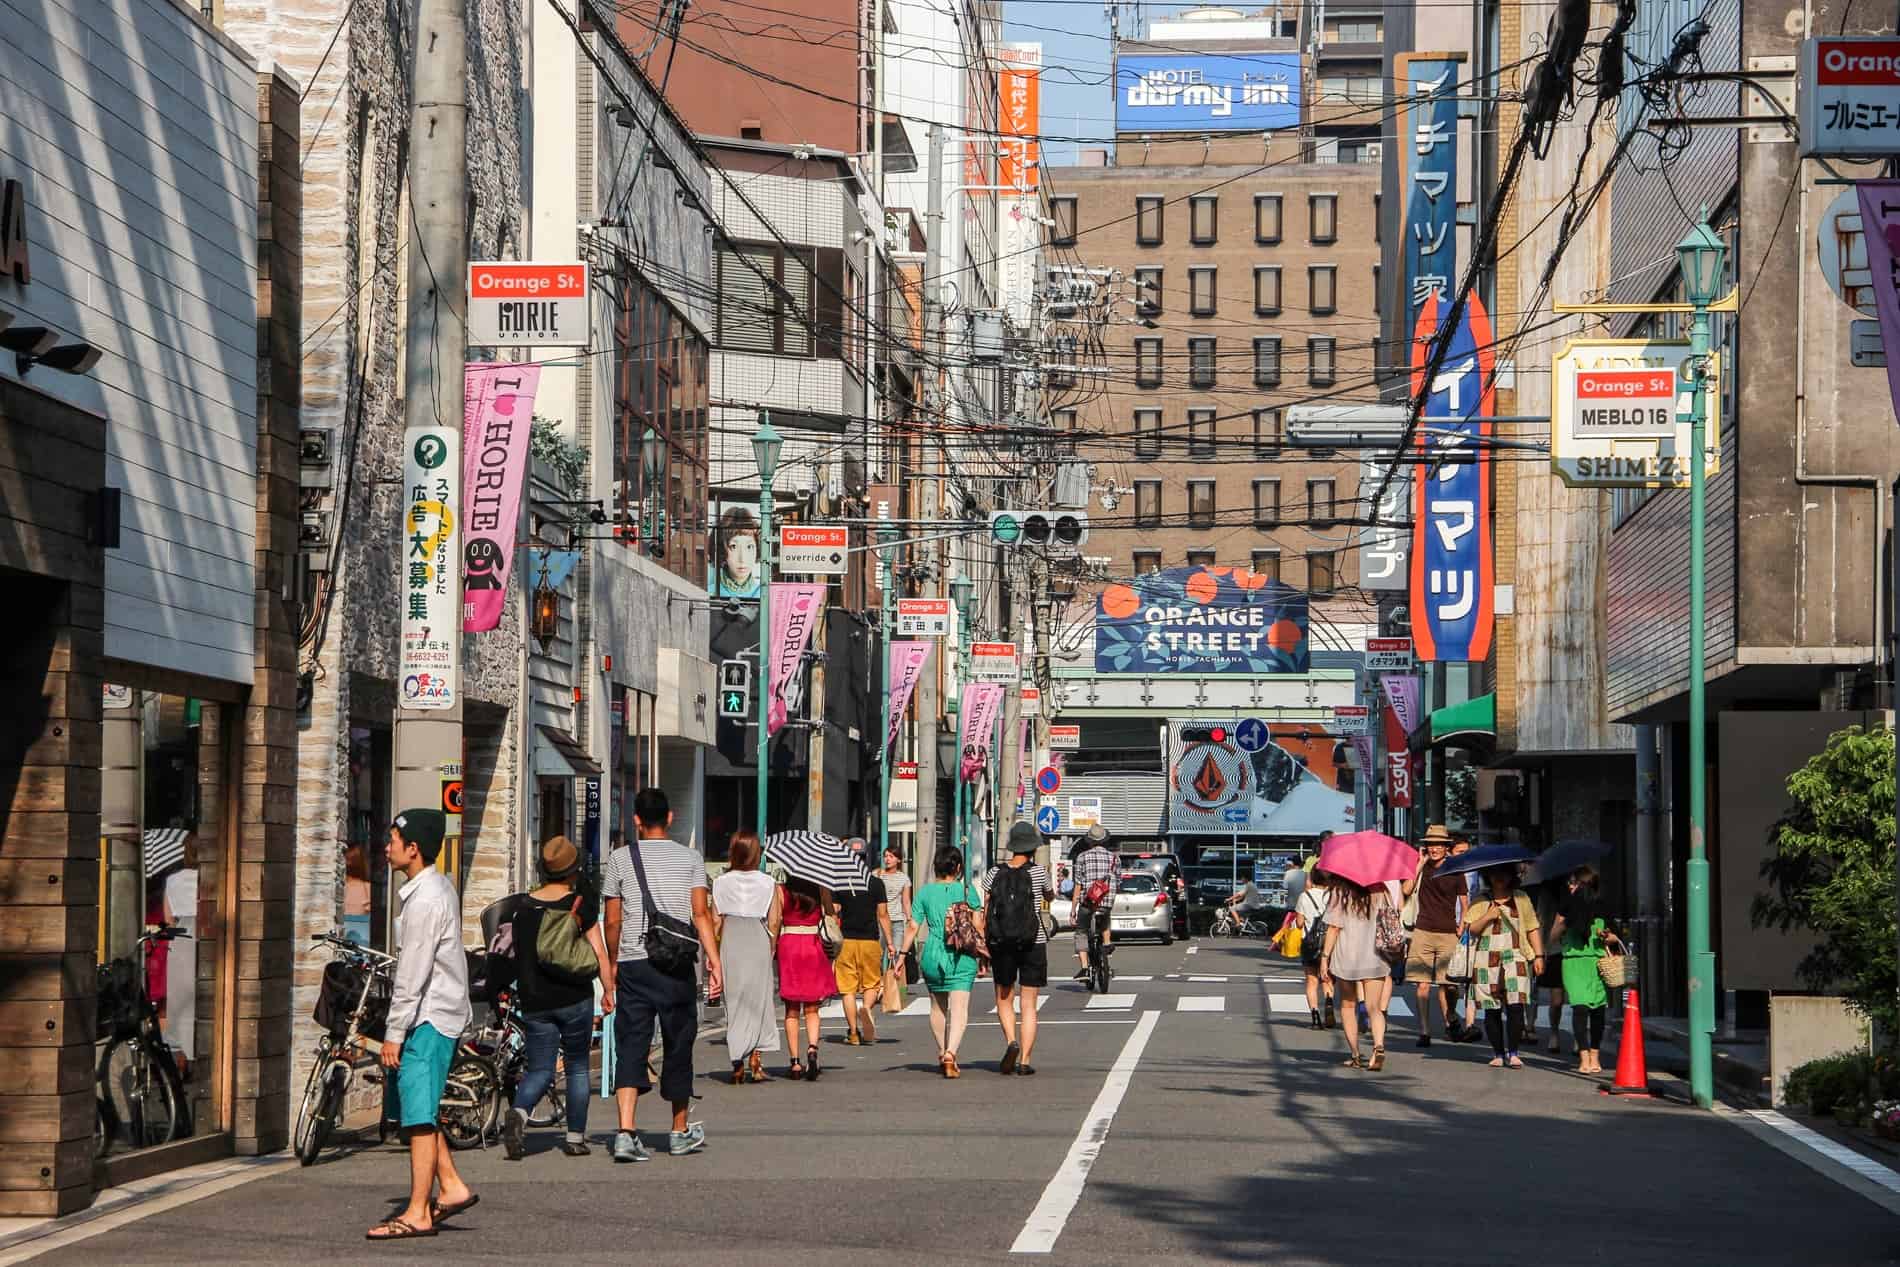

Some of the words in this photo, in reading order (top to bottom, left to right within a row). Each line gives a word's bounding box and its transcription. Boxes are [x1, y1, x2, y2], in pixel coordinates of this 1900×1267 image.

[1149, 70, 1205, 84] HOTEL
[1128, 75, 1232, 116] dormy
[1243, 84, 1288, 104] inn
[479, 273, 550, 293] Orange
[557, 273, 580, 288] St.
[499, 302, 558, 331] HORIE
[1582, 380, 1644, 395] Orange
[1650, 379, 1669, 391] St.
[1582, 409, 1644, 425] MEBLO
[1649, 409, 1667, 425] 16
[472, 420, 513, 531] HORIE
[1432, 358, 1475, 620] イチマツ
[435, 479, 449, 595] スマートになりました
[786, 530, 826, 543] Orange
[409, 485, 428, 620] 広告大募集
[785, 553, 826, 562] override
[1145, 607, 1264, 626] ORANGE
[1147, 632, 1263, 651] STREET
[1369, 642, 1398, 650] Orange
